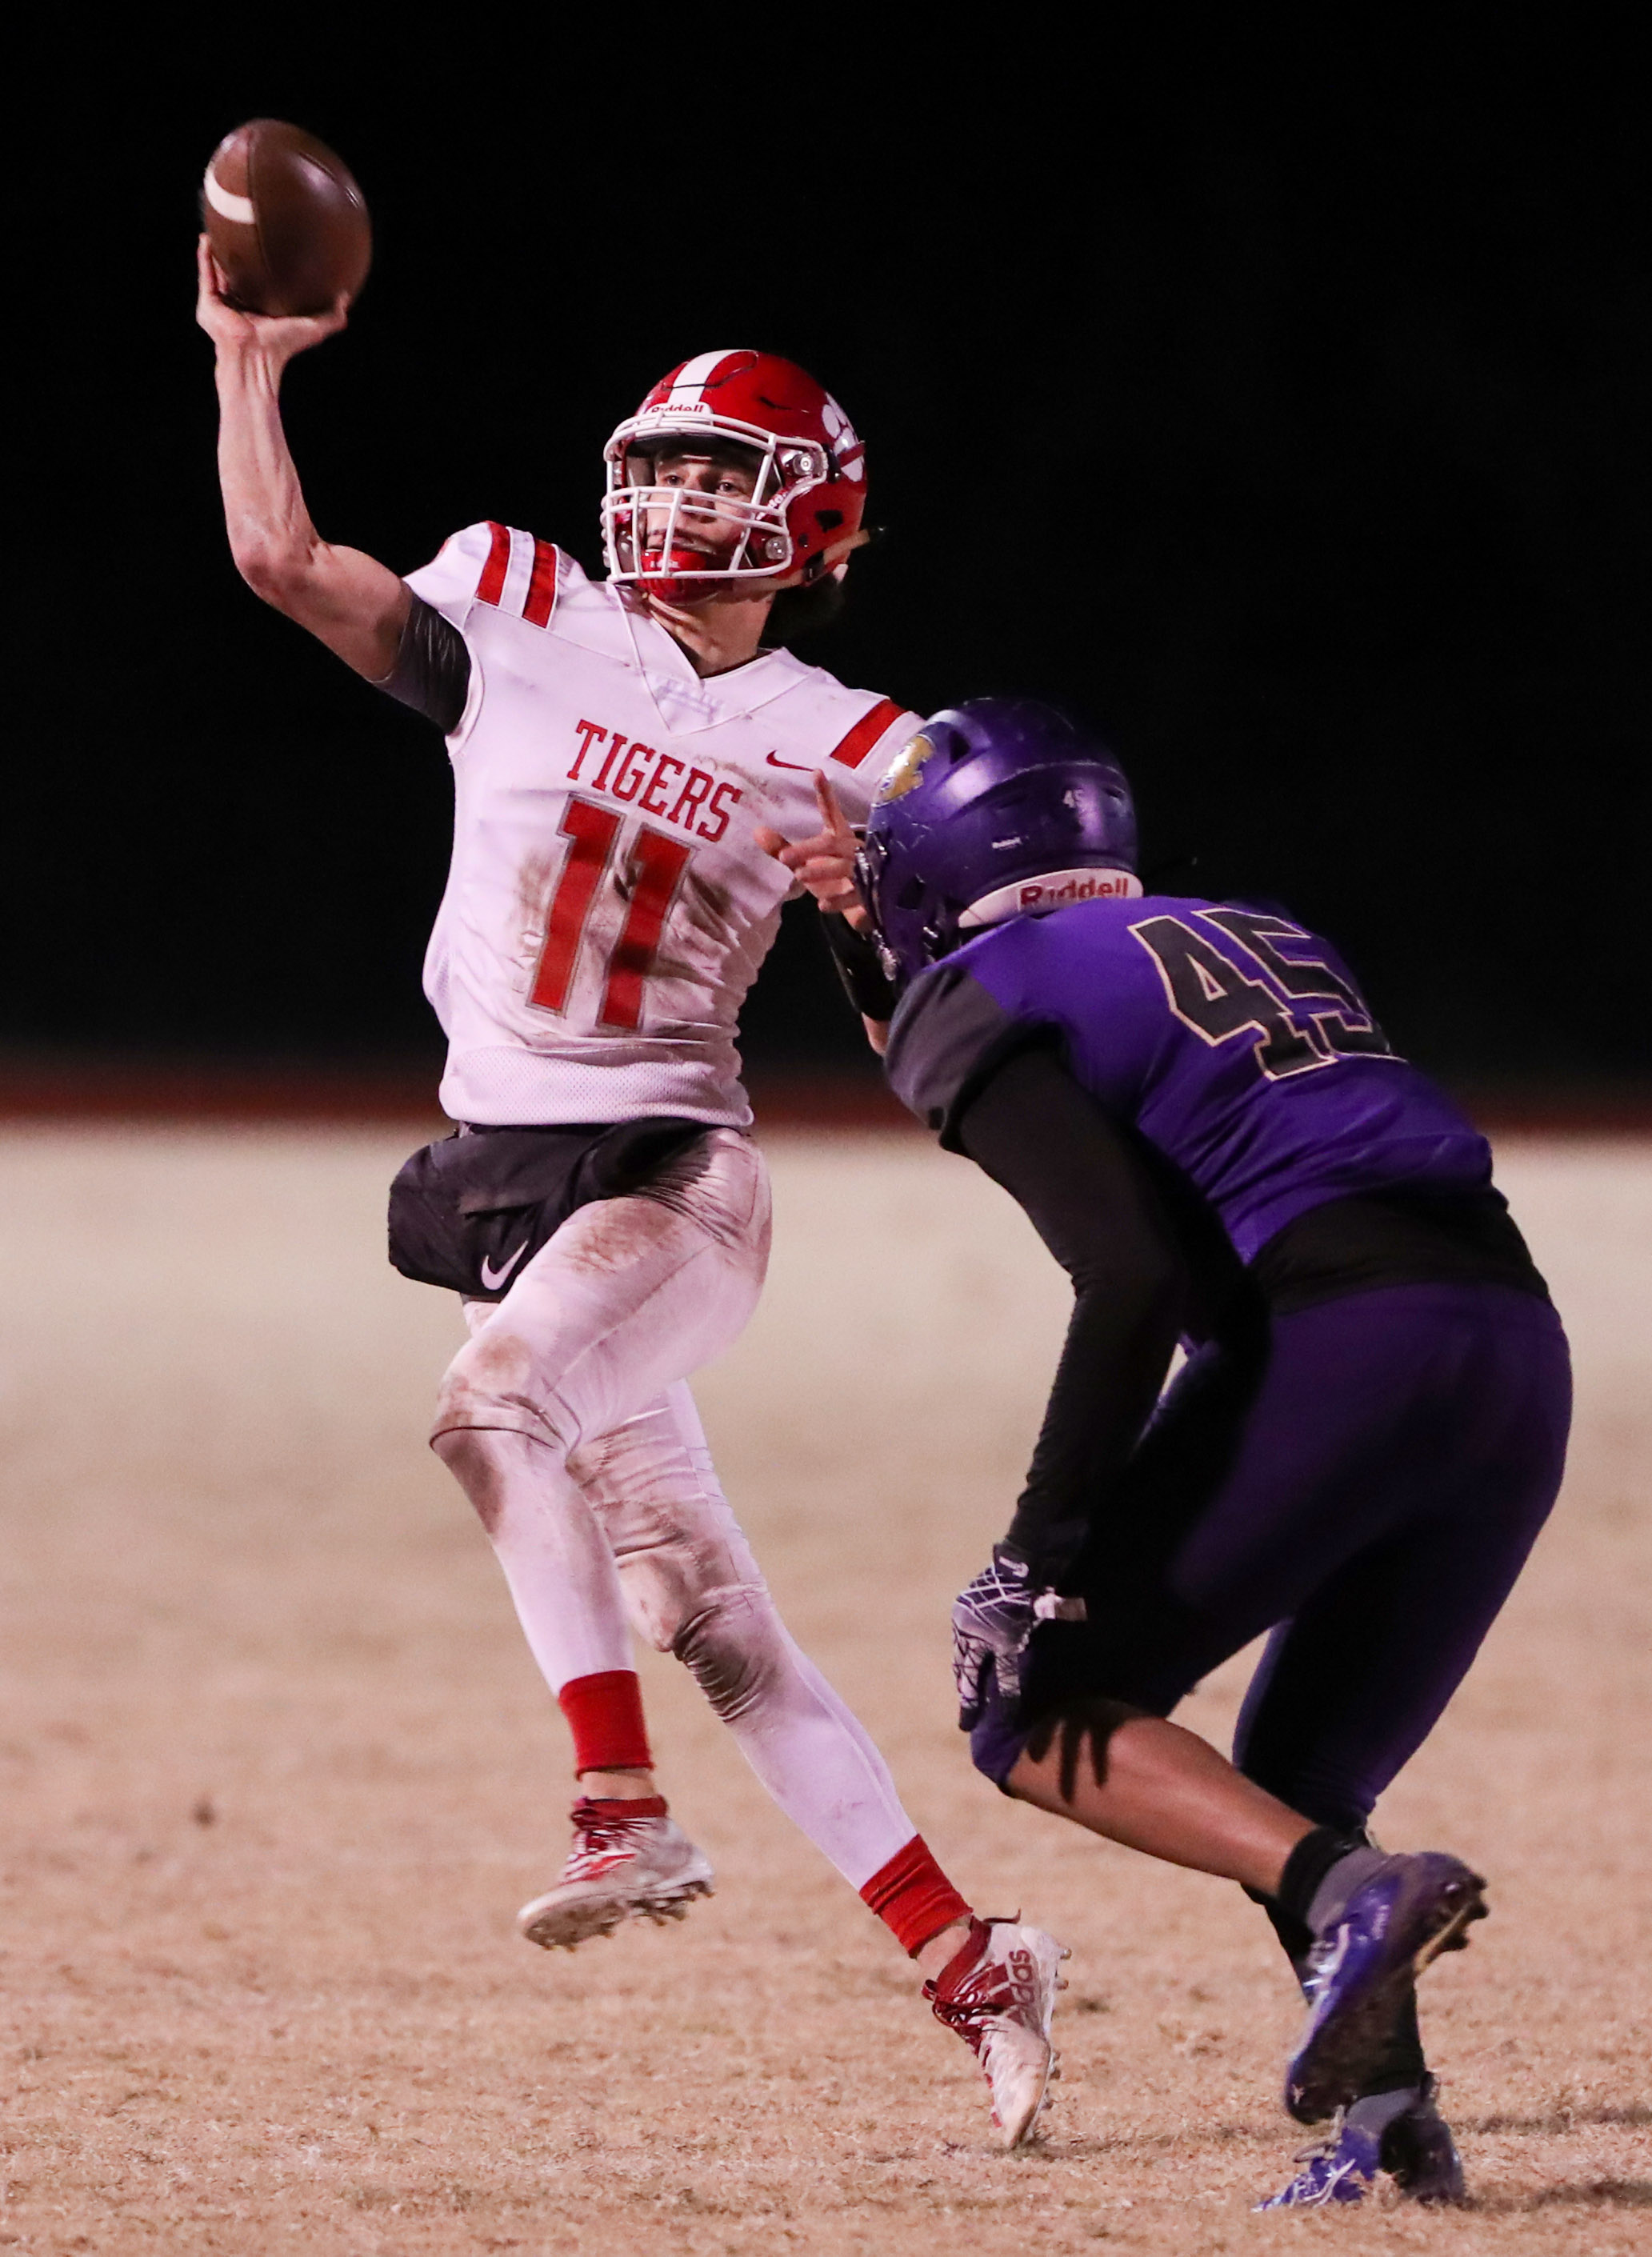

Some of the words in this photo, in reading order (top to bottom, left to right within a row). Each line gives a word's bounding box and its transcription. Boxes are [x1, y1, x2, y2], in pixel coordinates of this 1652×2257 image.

[566, 718, 742, 842] TIGERS
[525, 792, 701, 1031] 11
[1126, 907, 1406, 1081] 45
